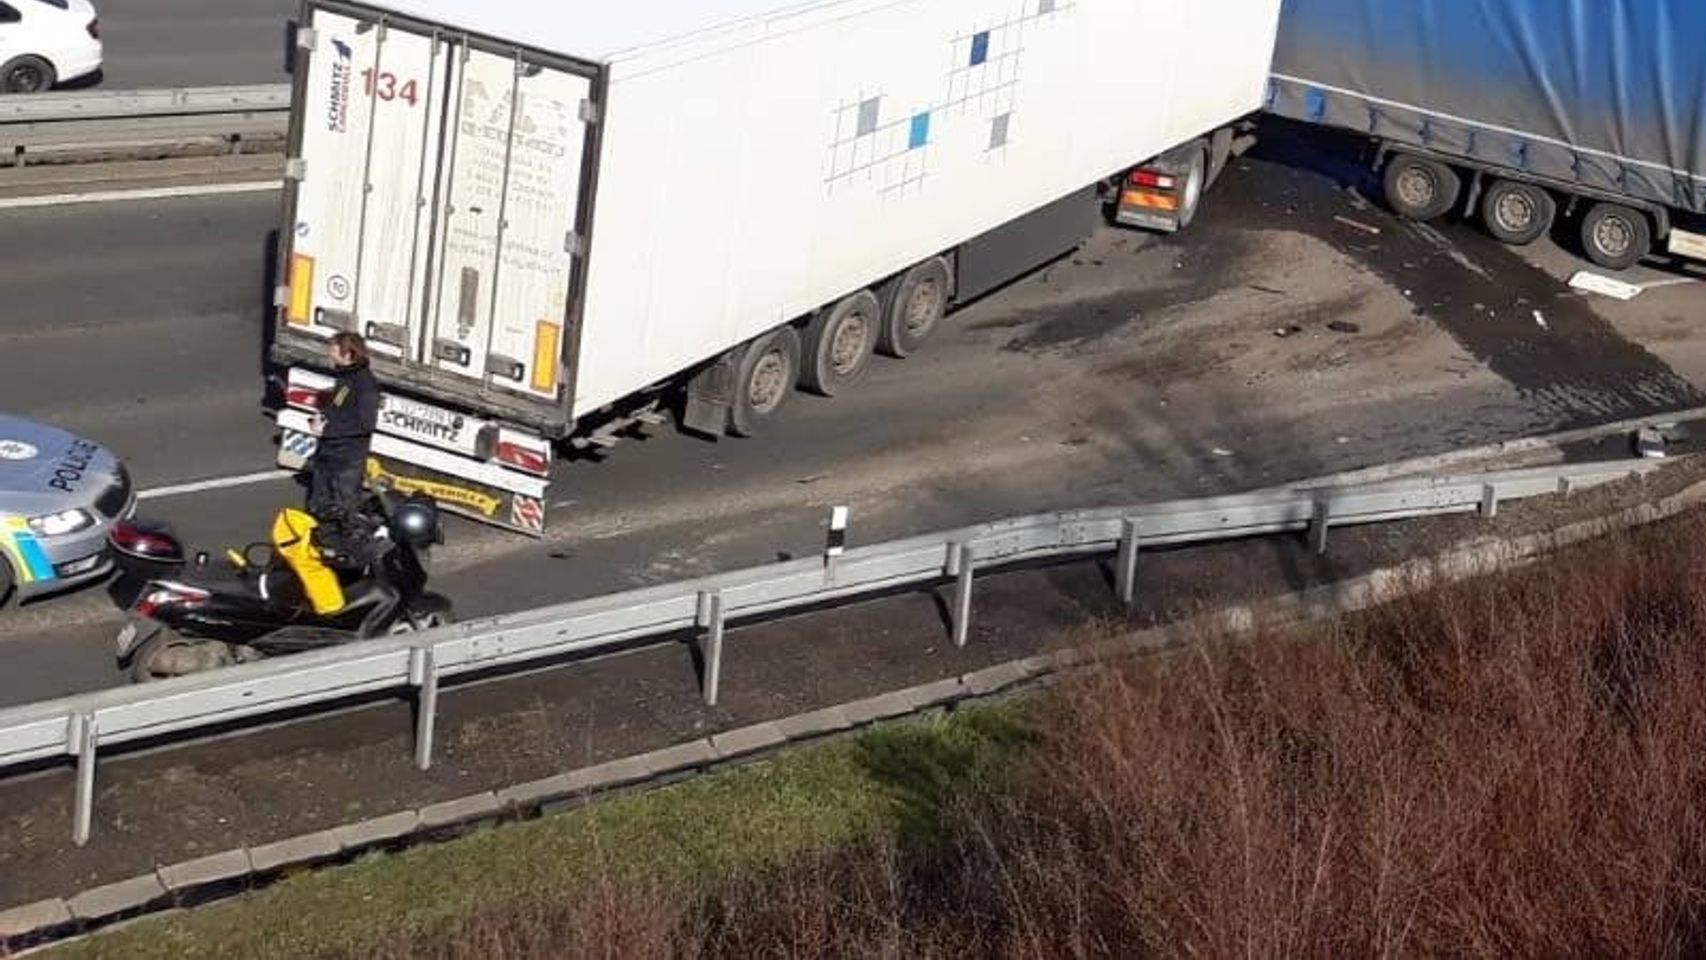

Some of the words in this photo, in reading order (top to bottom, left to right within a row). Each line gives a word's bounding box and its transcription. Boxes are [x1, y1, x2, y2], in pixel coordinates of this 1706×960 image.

[327, 62, 343, 132] SCHMITZ
[361, 67, 417, 107] 134
[382, 410, 461, 443] SCHMITZ
